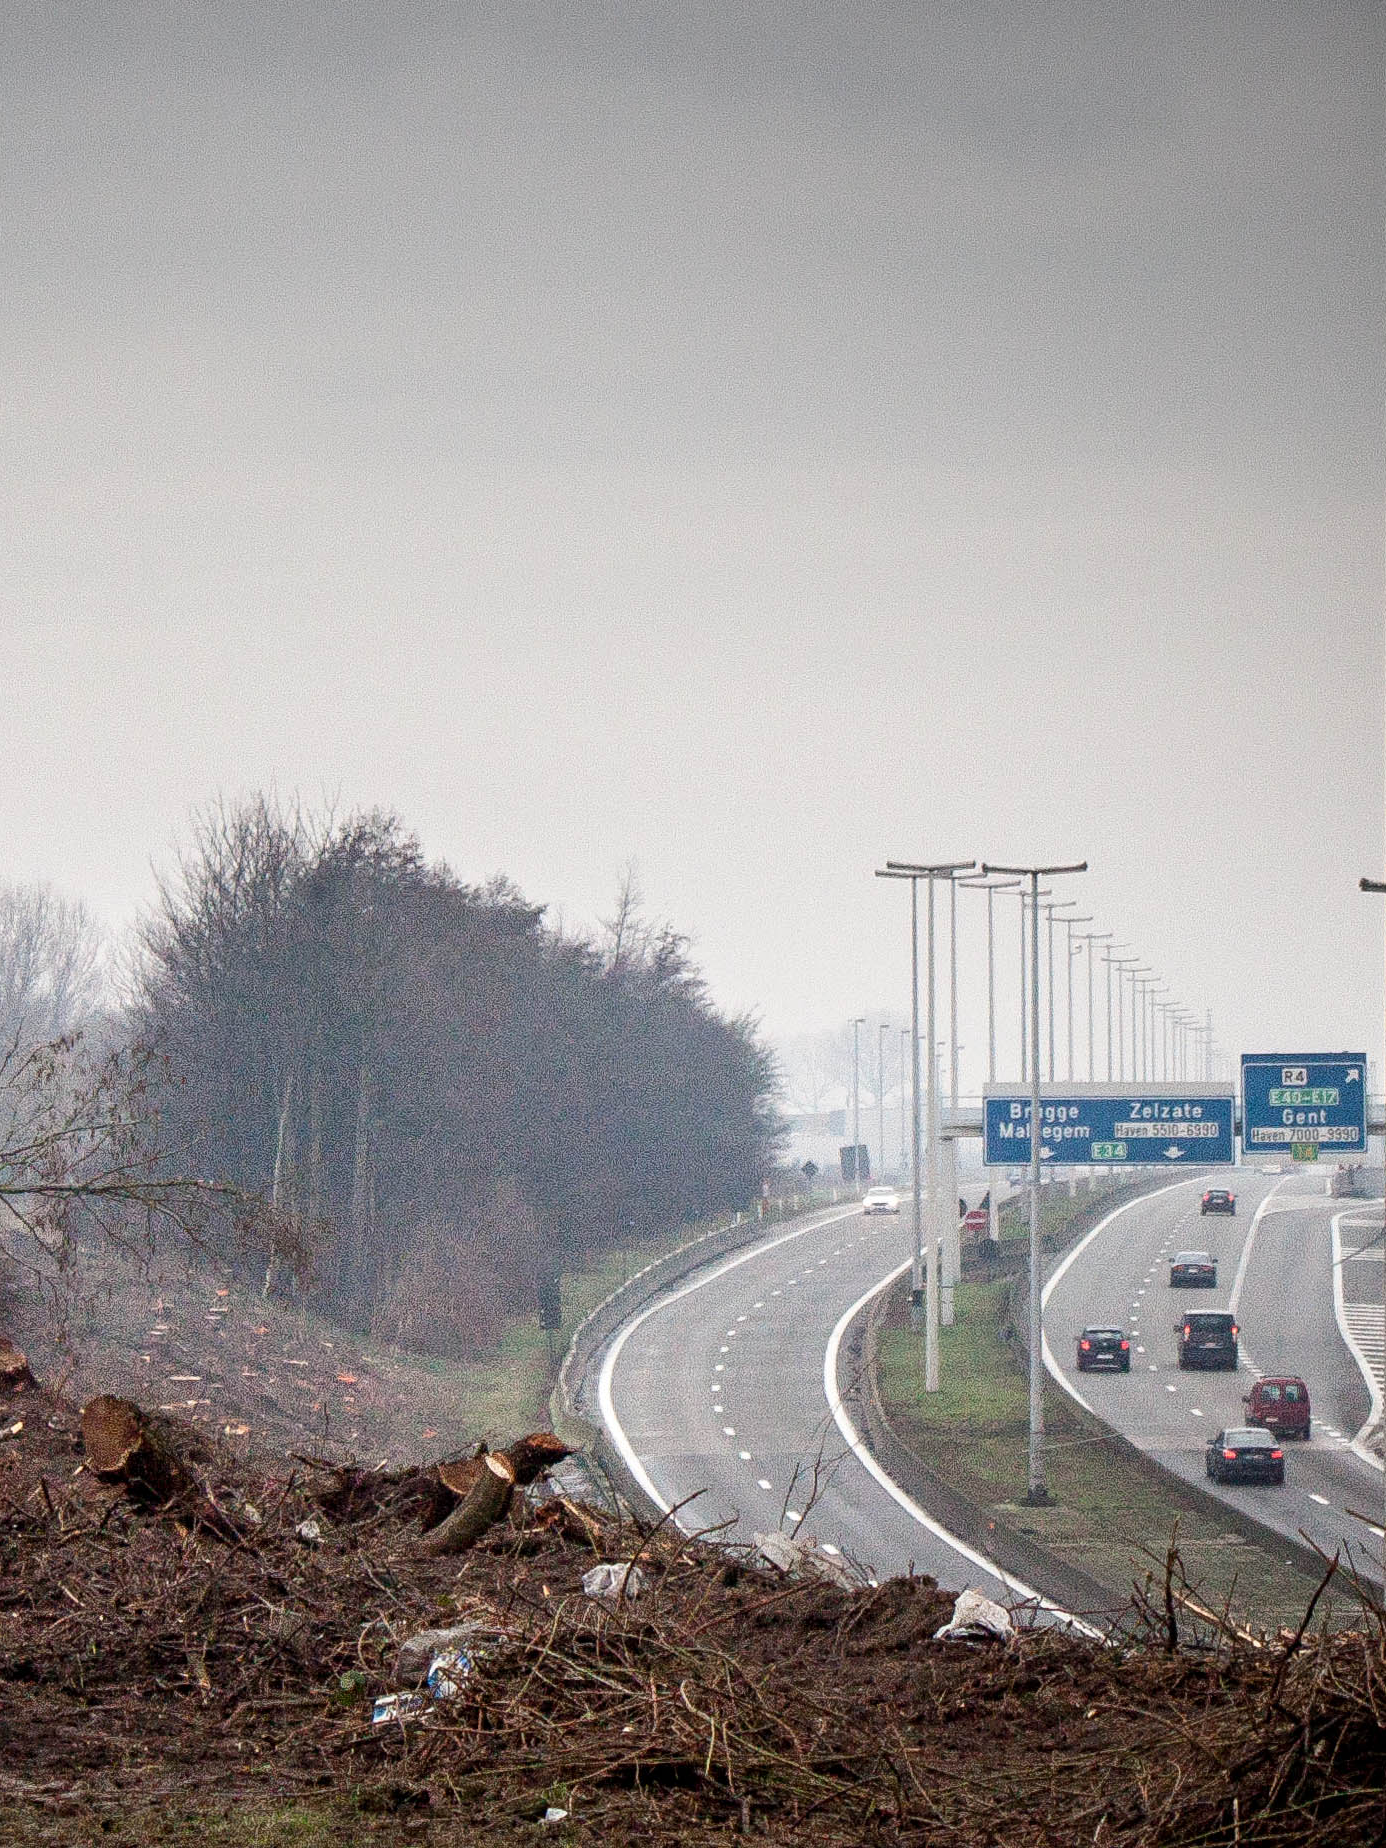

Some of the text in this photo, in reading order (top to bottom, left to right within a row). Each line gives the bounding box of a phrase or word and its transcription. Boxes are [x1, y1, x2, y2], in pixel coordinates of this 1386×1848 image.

[1284, 1070, 1305, 1083] R4
[1130, 1102, 1204, 1119] Zelzate
[1282, 1109, 1327, 1124] Gent
[999, 1122, 1091, 1142] Malegem
[1116, 1124, 1148, 1137] Haven
[1253, 1129, 1285, 1142] Haven
[1094, 1143, 1124, 1158] E34
